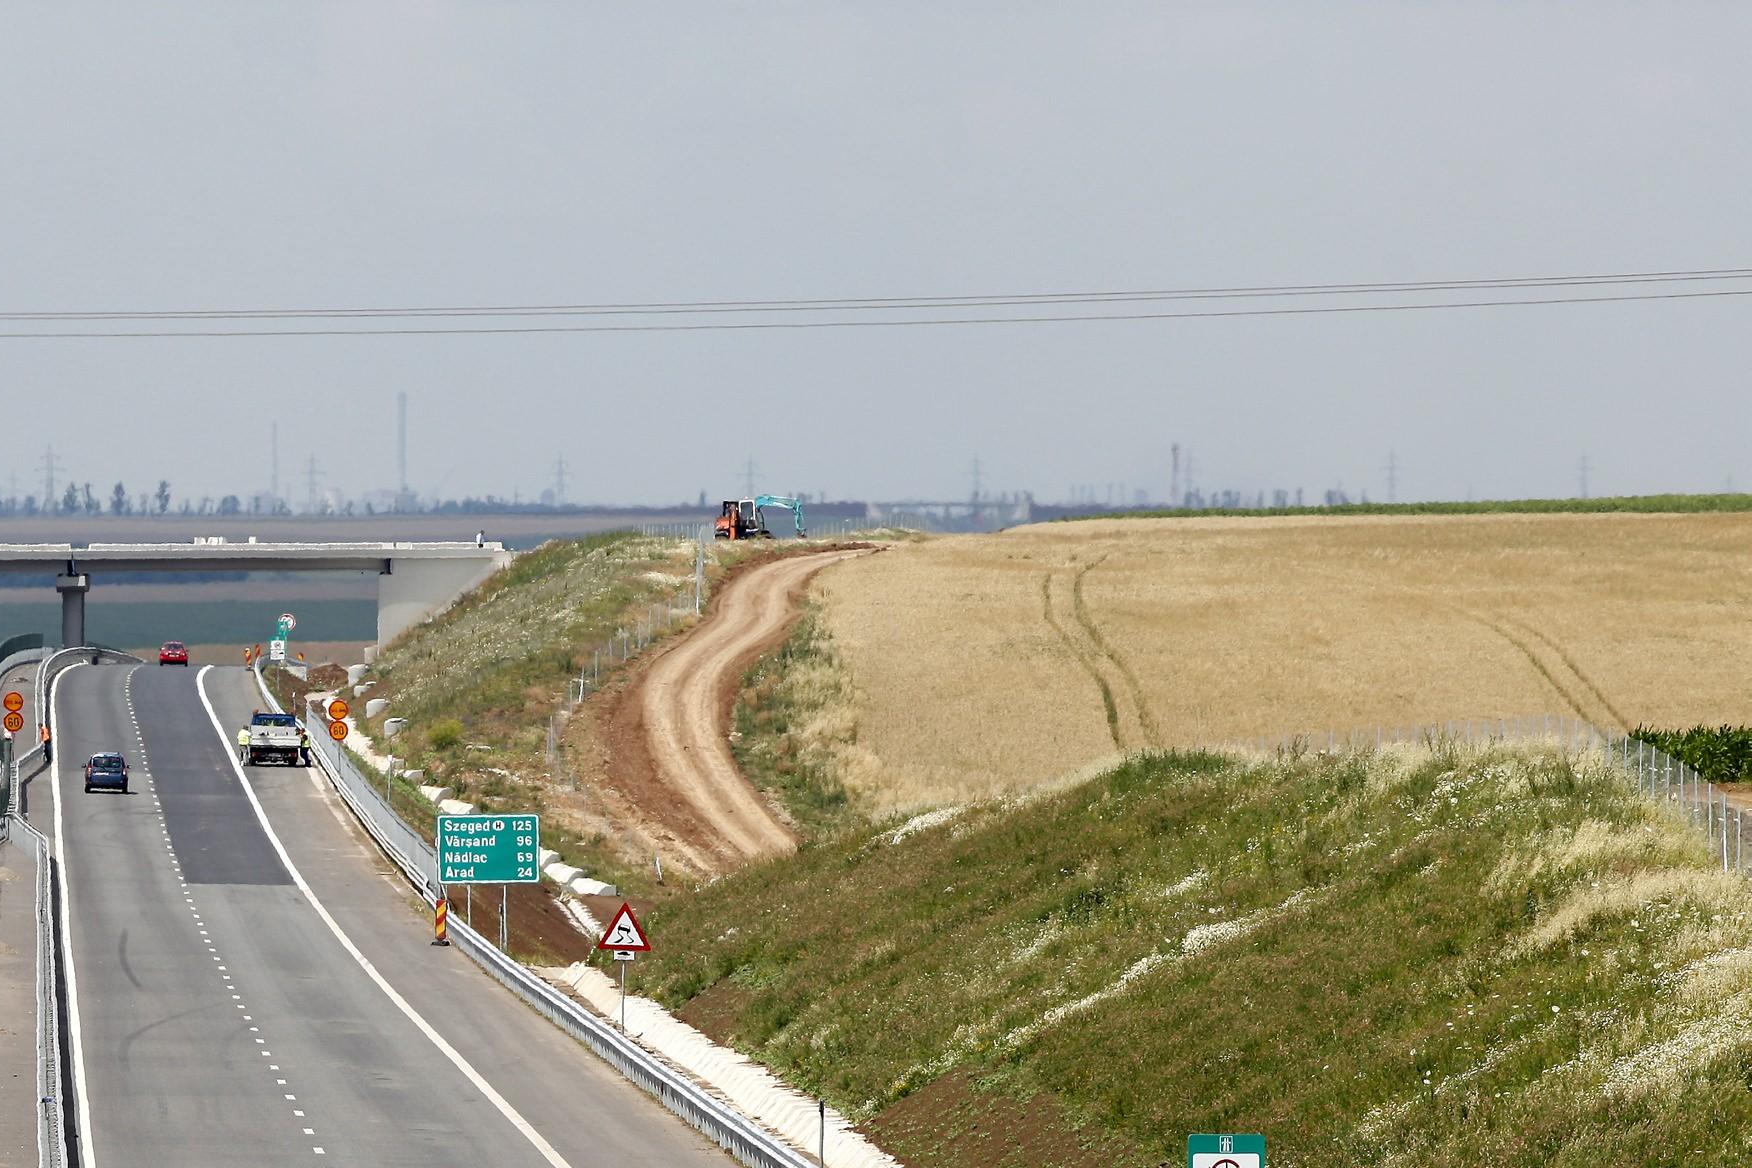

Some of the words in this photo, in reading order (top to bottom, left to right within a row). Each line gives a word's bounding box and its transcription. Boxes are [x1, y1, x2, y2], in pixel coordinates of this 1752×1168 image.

[8, 718, 19, 727] 60
[444, 820, 490, 834] Szeged
[512, 821, 532, 831] 125
[516, 836, 532, 846] 96
[445, 852, 488, 863] Nădlac
[517, 852, 533, 862] 69
[445, 866, 474, 878] Arad
[517, 867, 532, 877] 24
